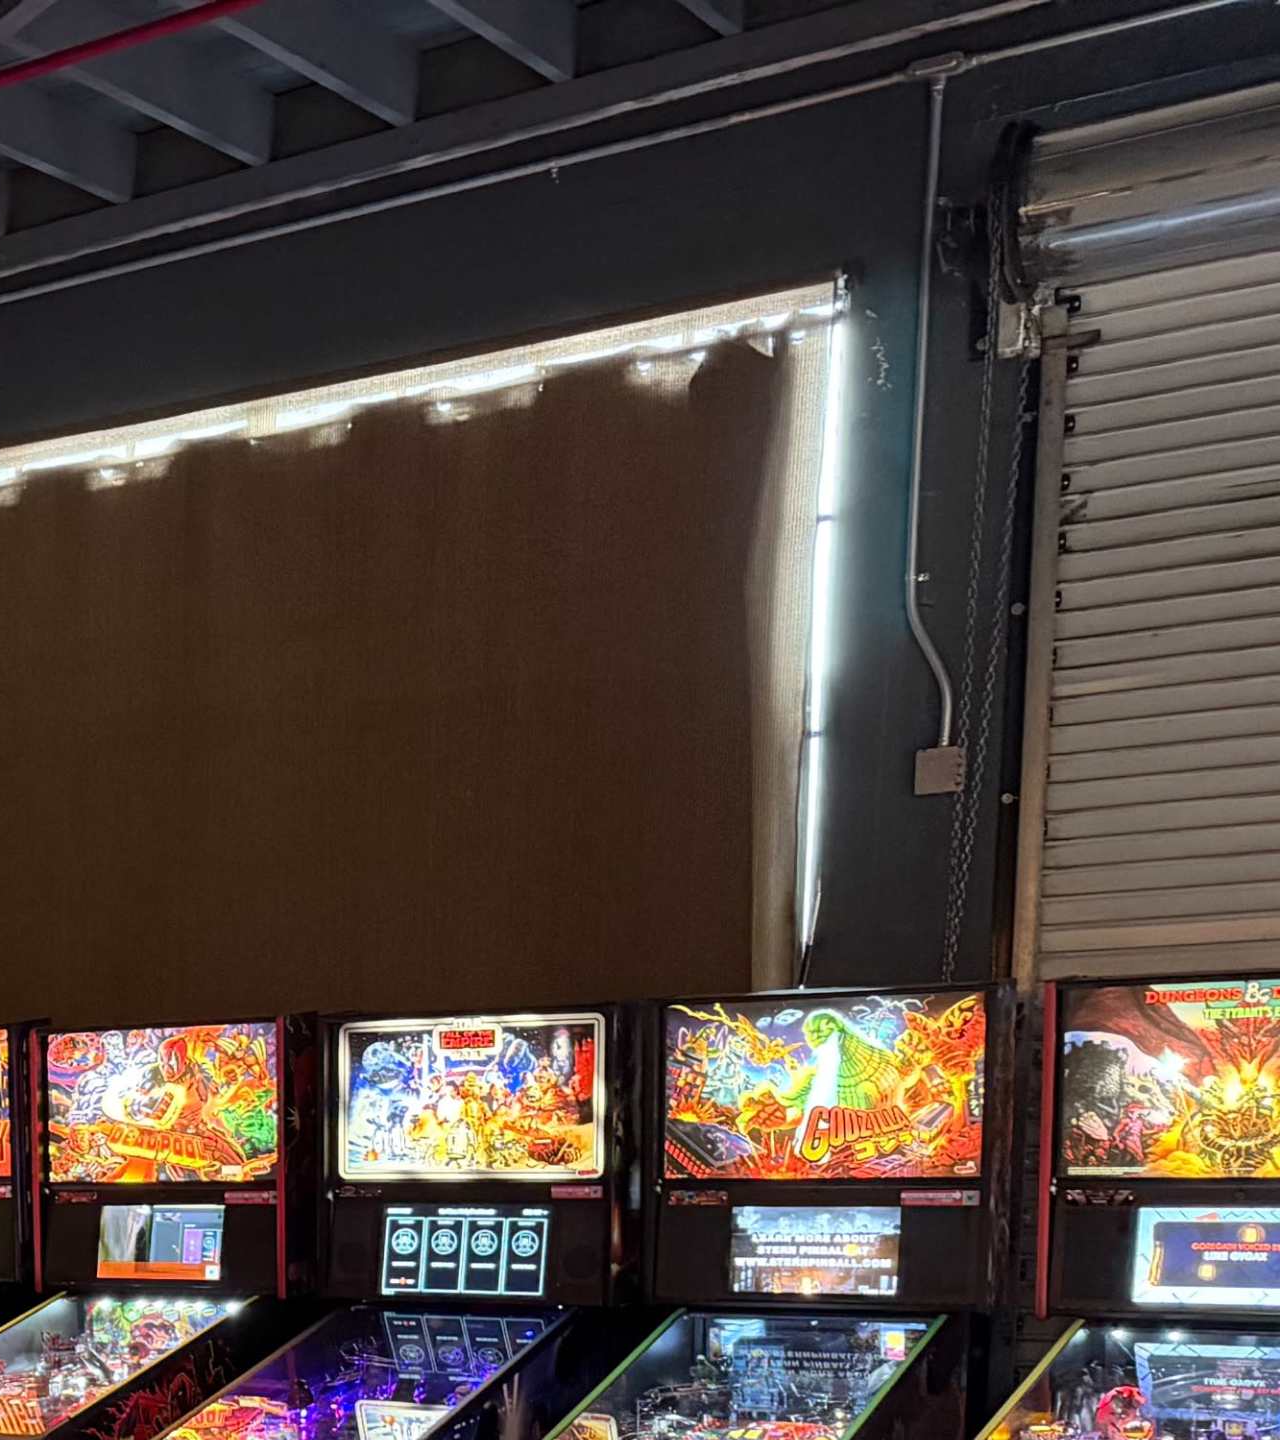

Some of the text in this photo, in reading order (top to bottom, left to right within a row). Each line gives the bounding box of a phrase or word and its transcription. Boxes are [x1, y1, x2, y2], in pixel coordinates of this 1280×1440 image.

[1144, 982, 1272, 1005] DUNGEONS &
[441, 1036, 494, 1048] EMPIRE
[107, 1122, 209, 1162] DEADPOOL
[801, 1105, 910, 1162] GODZILLA
[752, 1234, 877, 1243] LEARN MORE ABOUT
